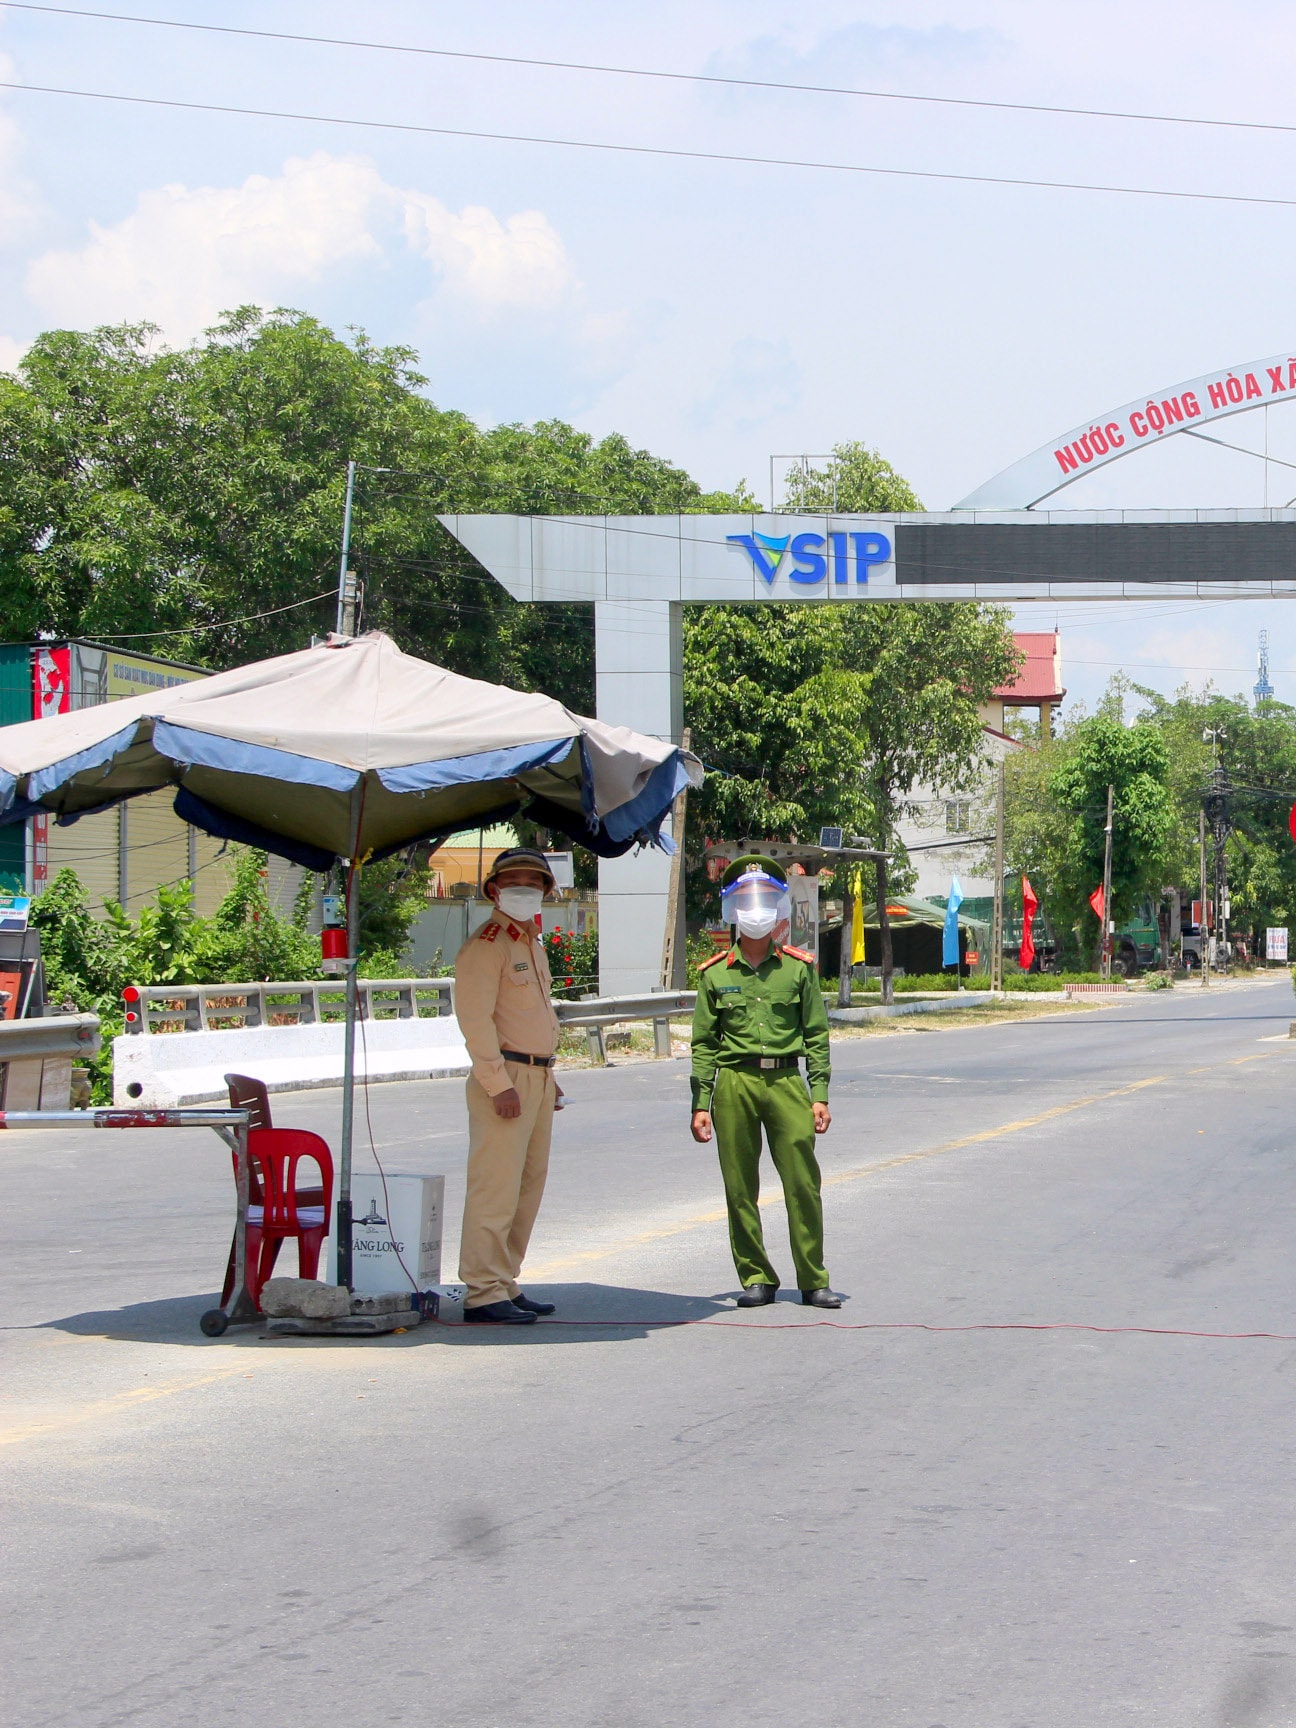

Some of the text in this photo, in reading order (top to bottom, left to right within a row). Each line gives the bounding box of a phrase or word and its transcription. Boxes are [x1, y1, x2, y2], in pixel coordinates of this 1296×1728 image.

[1054, 424, 1125, 474] NƯỚC
[1129, 391, 1201, 438] CỘNG
[1207, 372, 1263, 409] HÒA
[725, 530, 891, 585] VSIP
[377, 1241, 405, 1252] LONG
